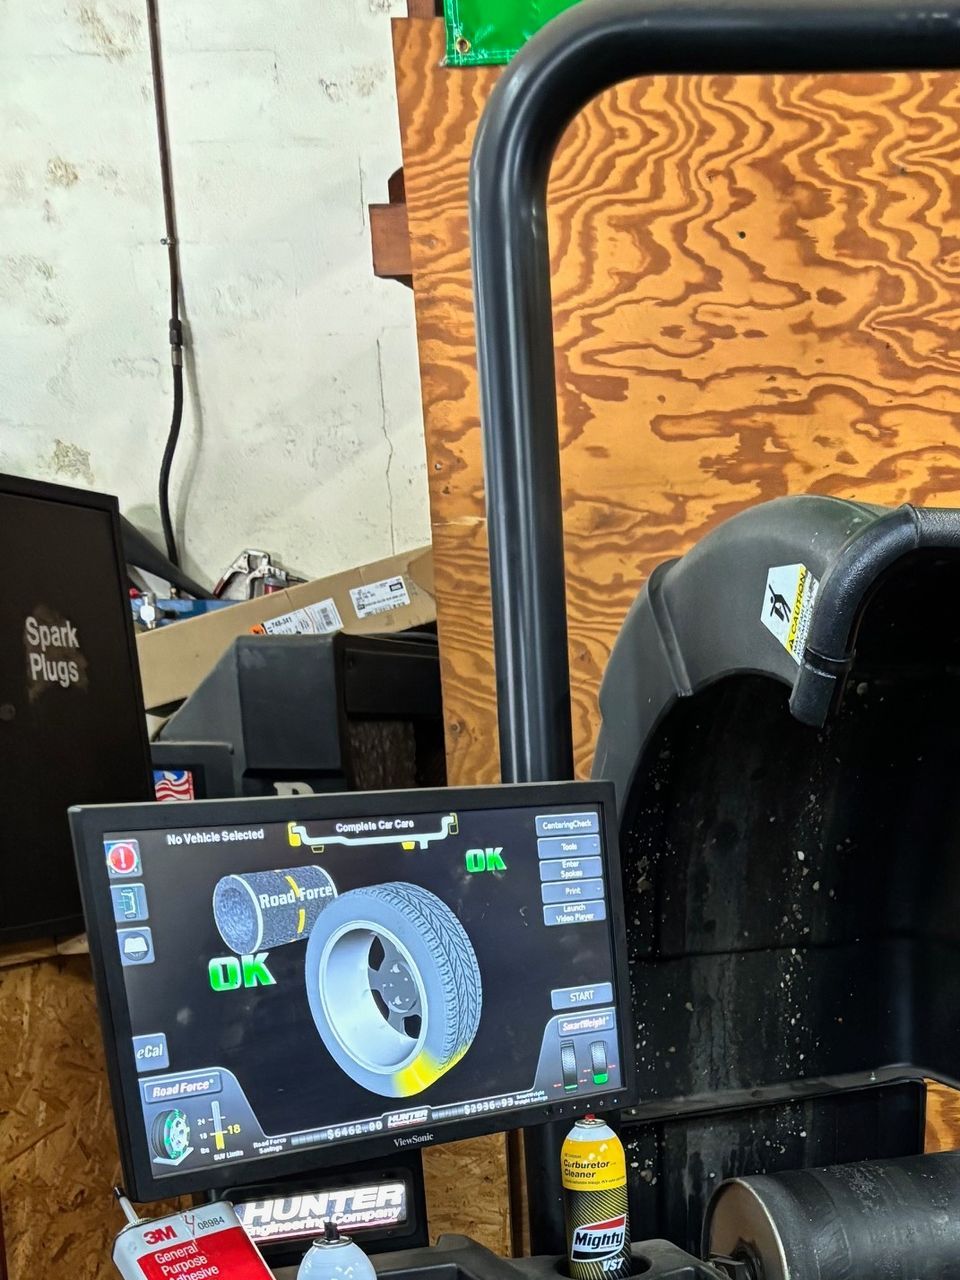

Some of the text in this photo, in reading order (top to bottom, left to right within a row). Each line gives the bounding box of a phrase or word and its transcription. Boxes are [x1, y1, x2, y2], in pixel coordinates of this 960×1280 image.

[792, 573, 806, 634] CAUTION
[25, 616, 80, 652] Spark
[28, 652, 80, 688] Plugs
[335, 819, 414, 833] Complete Car Care
[166, 828, 265, 845] No Vehicle Selected
[465, 847, 507, 873] OK
[259, 885, 333, 909] Road Force
[565, 887, 581, 895] Print
[208, 952, 277, 992] OK
[570, 990, 594, 1002] START
[136, 1044, 163, 1058] eCal
[152, 1080, 209, 1098] Road Force
[388, 1109, 428, 1123] HUNTER
[327, 1121, 383, 1140] $6462.00
[393, 1132, 434, 1148] ViewSonic
[564, 1158, 609, 1170] Carburetor
[564, 1168, 596, 1179] Cleaner
[243, 1184, 404, 1225] HUNTER
[197, 1216, 225, 1230] 08984
[330, 1206, 401, 1225] Company
[143, 1225, 178, 1245] 3M
[574, 1231, 624, 1250] Mighty
[154, 1242, 199, 1264] General
[160, 1255, 208, 1277] Purpose
[602, 1257, 625, 1272] VS7
